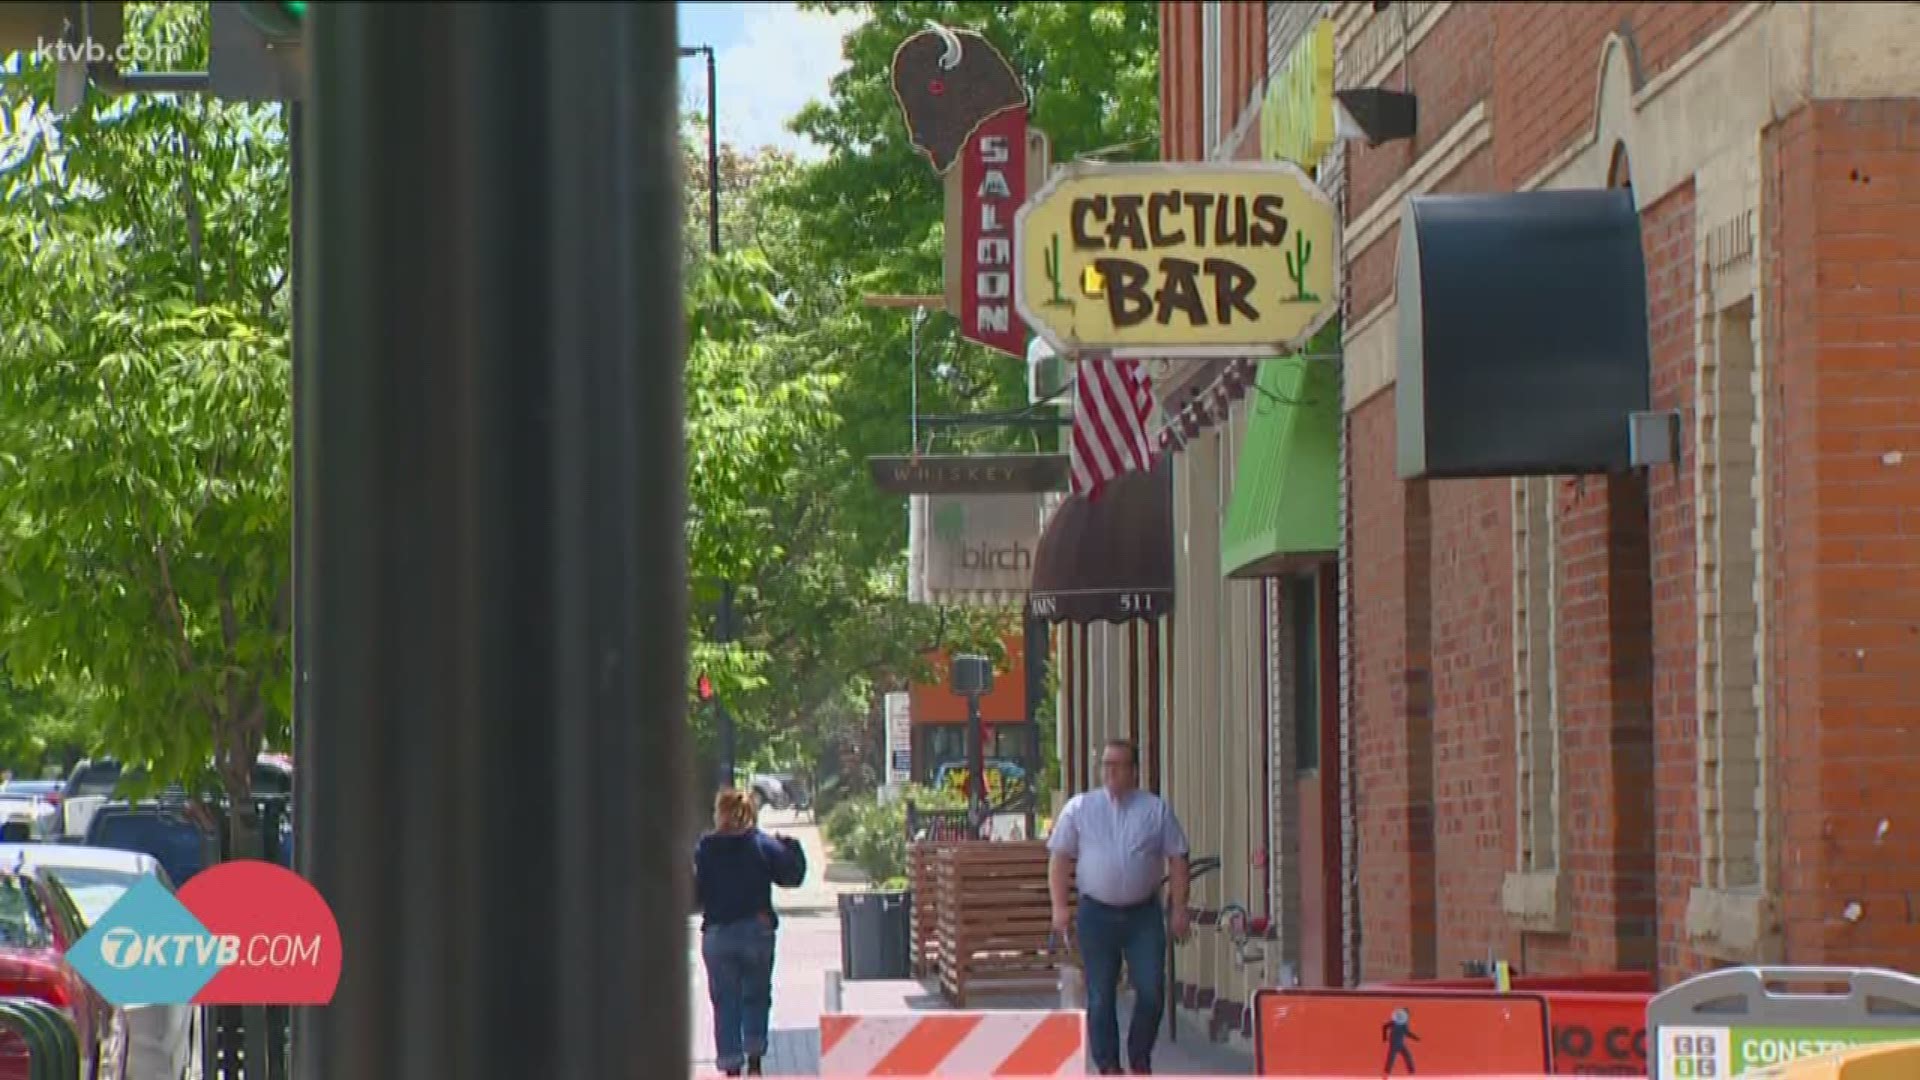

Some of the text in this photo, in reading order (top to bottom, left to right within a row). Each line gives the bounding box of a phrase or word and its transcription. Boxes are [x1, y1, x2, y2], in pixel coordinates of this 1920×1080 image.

[977, 135, 1011, 334] SALOON
[1071, 190, 1288, 250] CACTUS
[1095, 257, 1261, 328] BAR
[894, 466, 1015, 482] WHISKEY
[962, 540, 1031, 570] birch
[1120, 593, 1152, 612] 511
